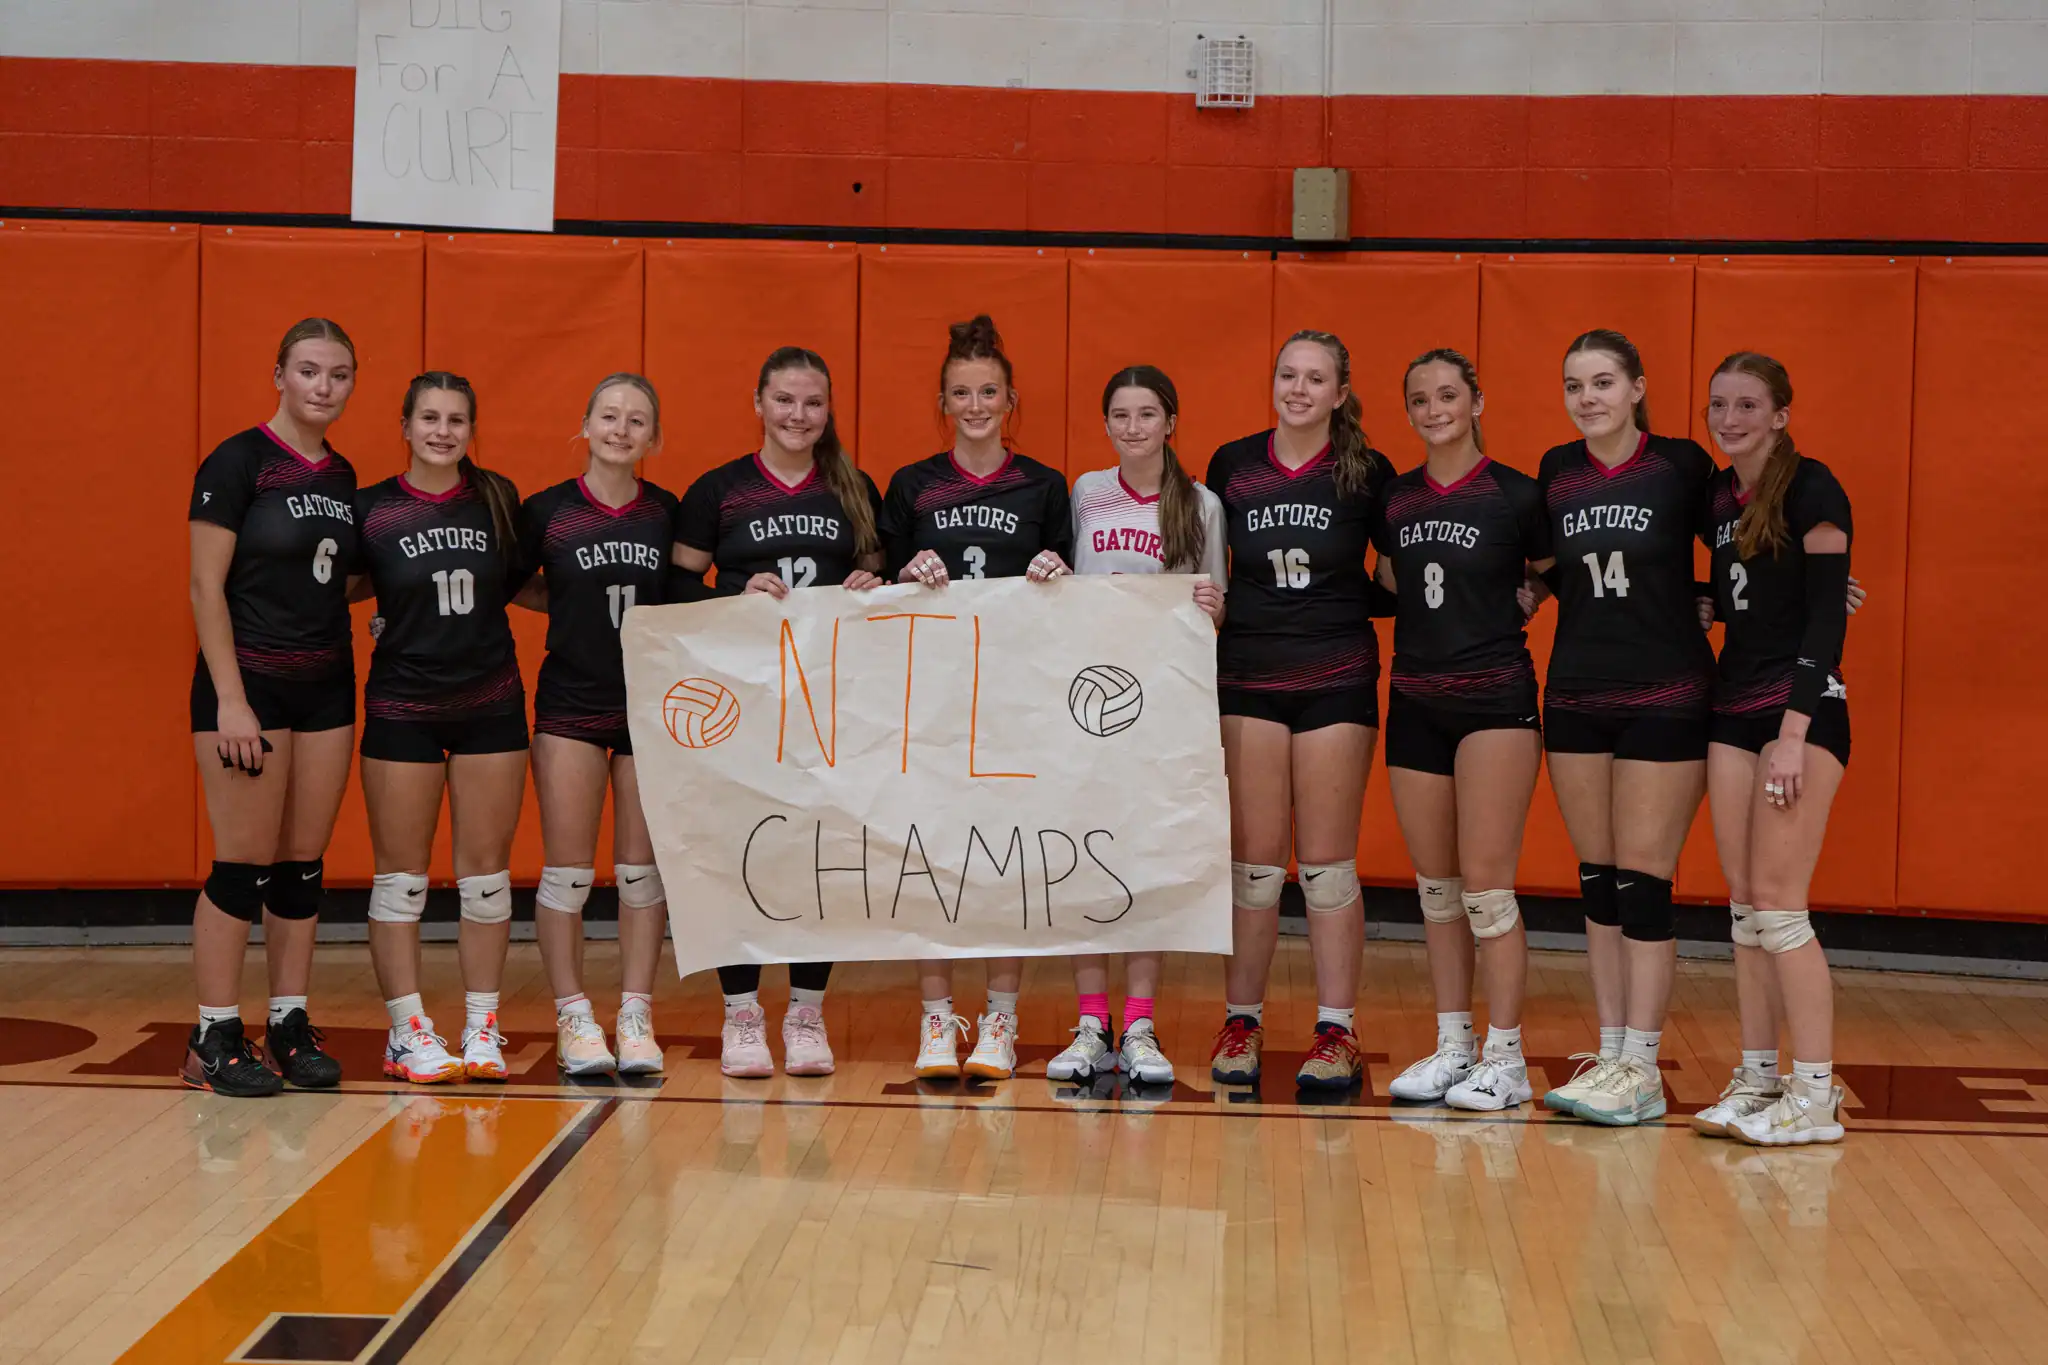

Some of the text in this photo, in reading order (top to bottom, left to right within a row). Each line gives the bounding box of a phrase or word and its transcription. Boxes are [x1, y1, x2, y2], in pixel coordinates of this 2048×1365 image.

[374, 34, 535, 100] For A
[381, 102, 544, 193] CURE
[286, 493, 354, 526] GATORS
[749, 514, 839, 542] GATORS
[934, 505, 1019, 534] GATORS
[1247, 503, 1332, 532] GATORS
[1563, 504, 1652, 537] GATORS
[399, 527, 487, 558] GATORS
[1093, 528, 1167, 563] GATOR
[1400, 520, 1480, 549] GATORS
[312, 538, 338, 585] 6
[575, 541, 660, 571] GATORS
[777, 556, 817, 589] 12
[962, 546, 986, 580] 3
[1267, 548, 1310, 589] 16
[1582, 551, 1629, 598] 14
[432, 568, 474, 616] 10
[1424, 562, 1444, 609] 8
[1729, 562, 1748, 611] 2
[605, 584, 636, 629] 11
[777, 612, 1037, 779] NTL
[742, 814, 1133, 931] CHAMPS
